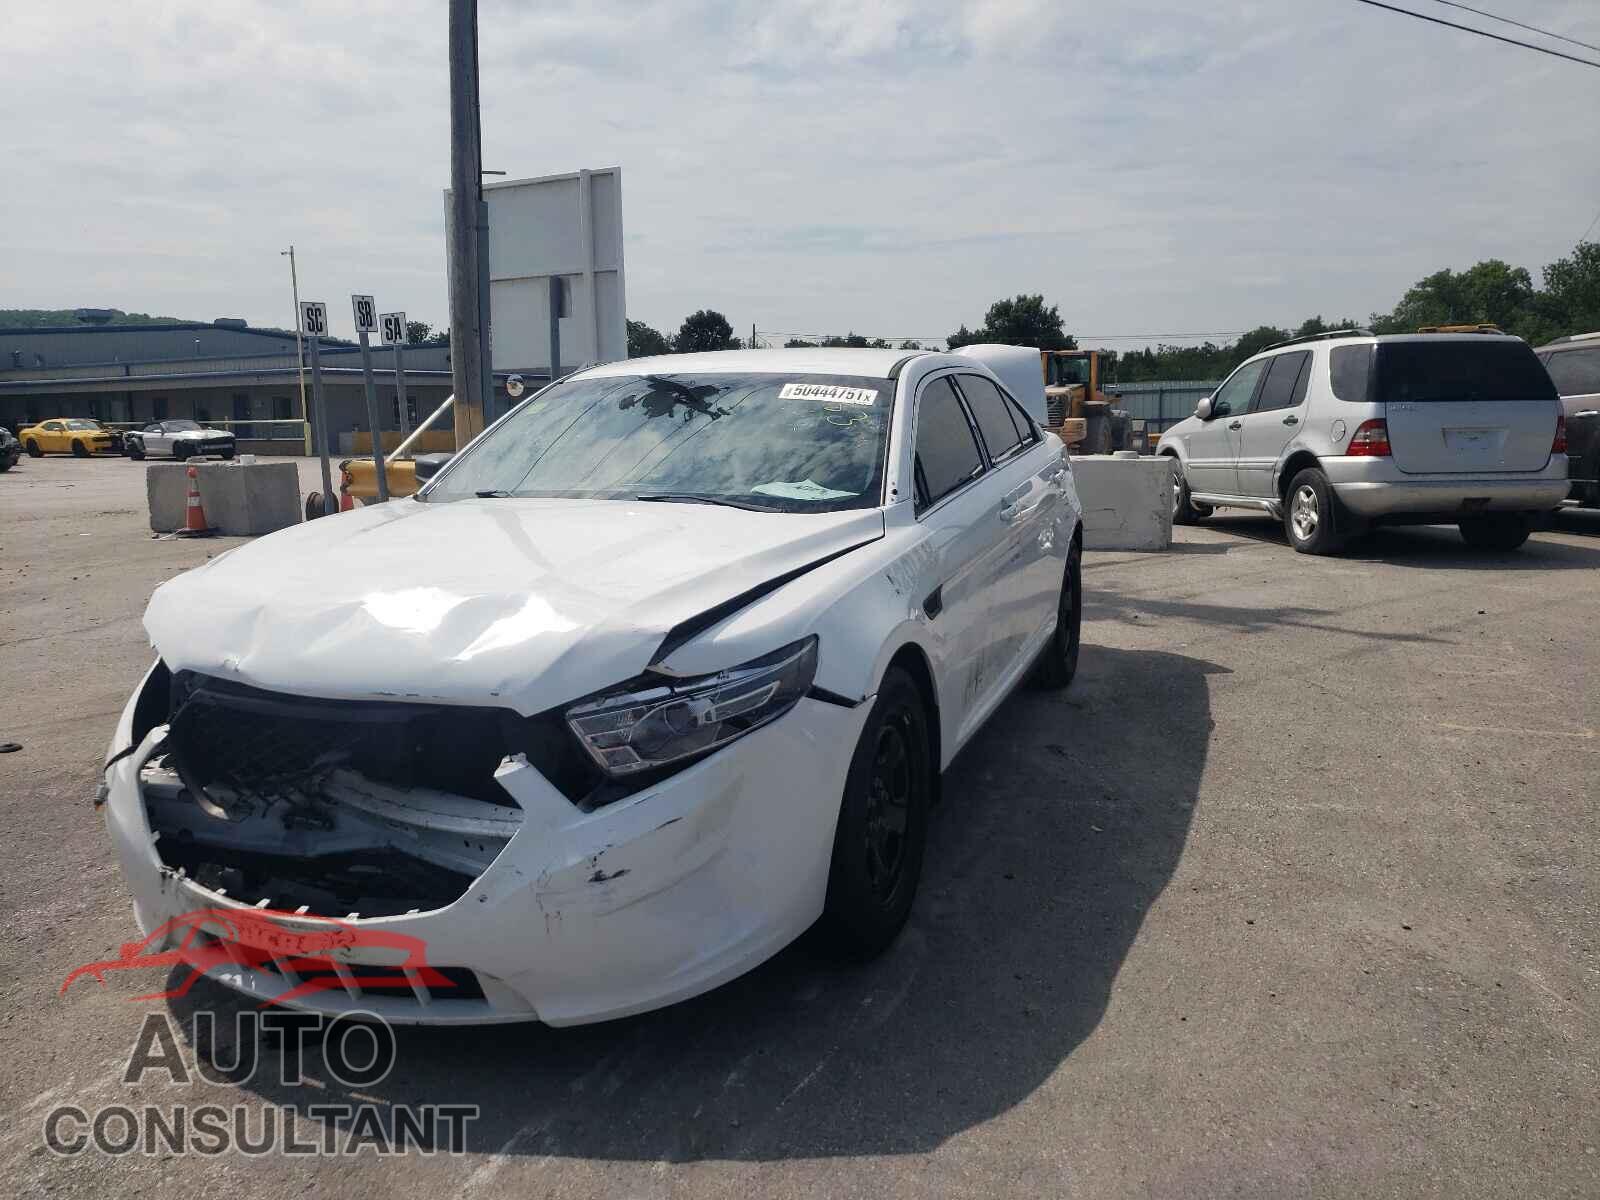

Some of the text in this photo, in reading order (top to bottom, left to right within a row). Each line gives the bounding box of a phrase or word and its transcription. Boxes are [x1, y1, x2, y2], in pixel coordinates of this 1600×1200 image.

[306, 307, 323, 333] SC
[357, 301, 373, 327] SB
[384, 317, 402, 340] SA
